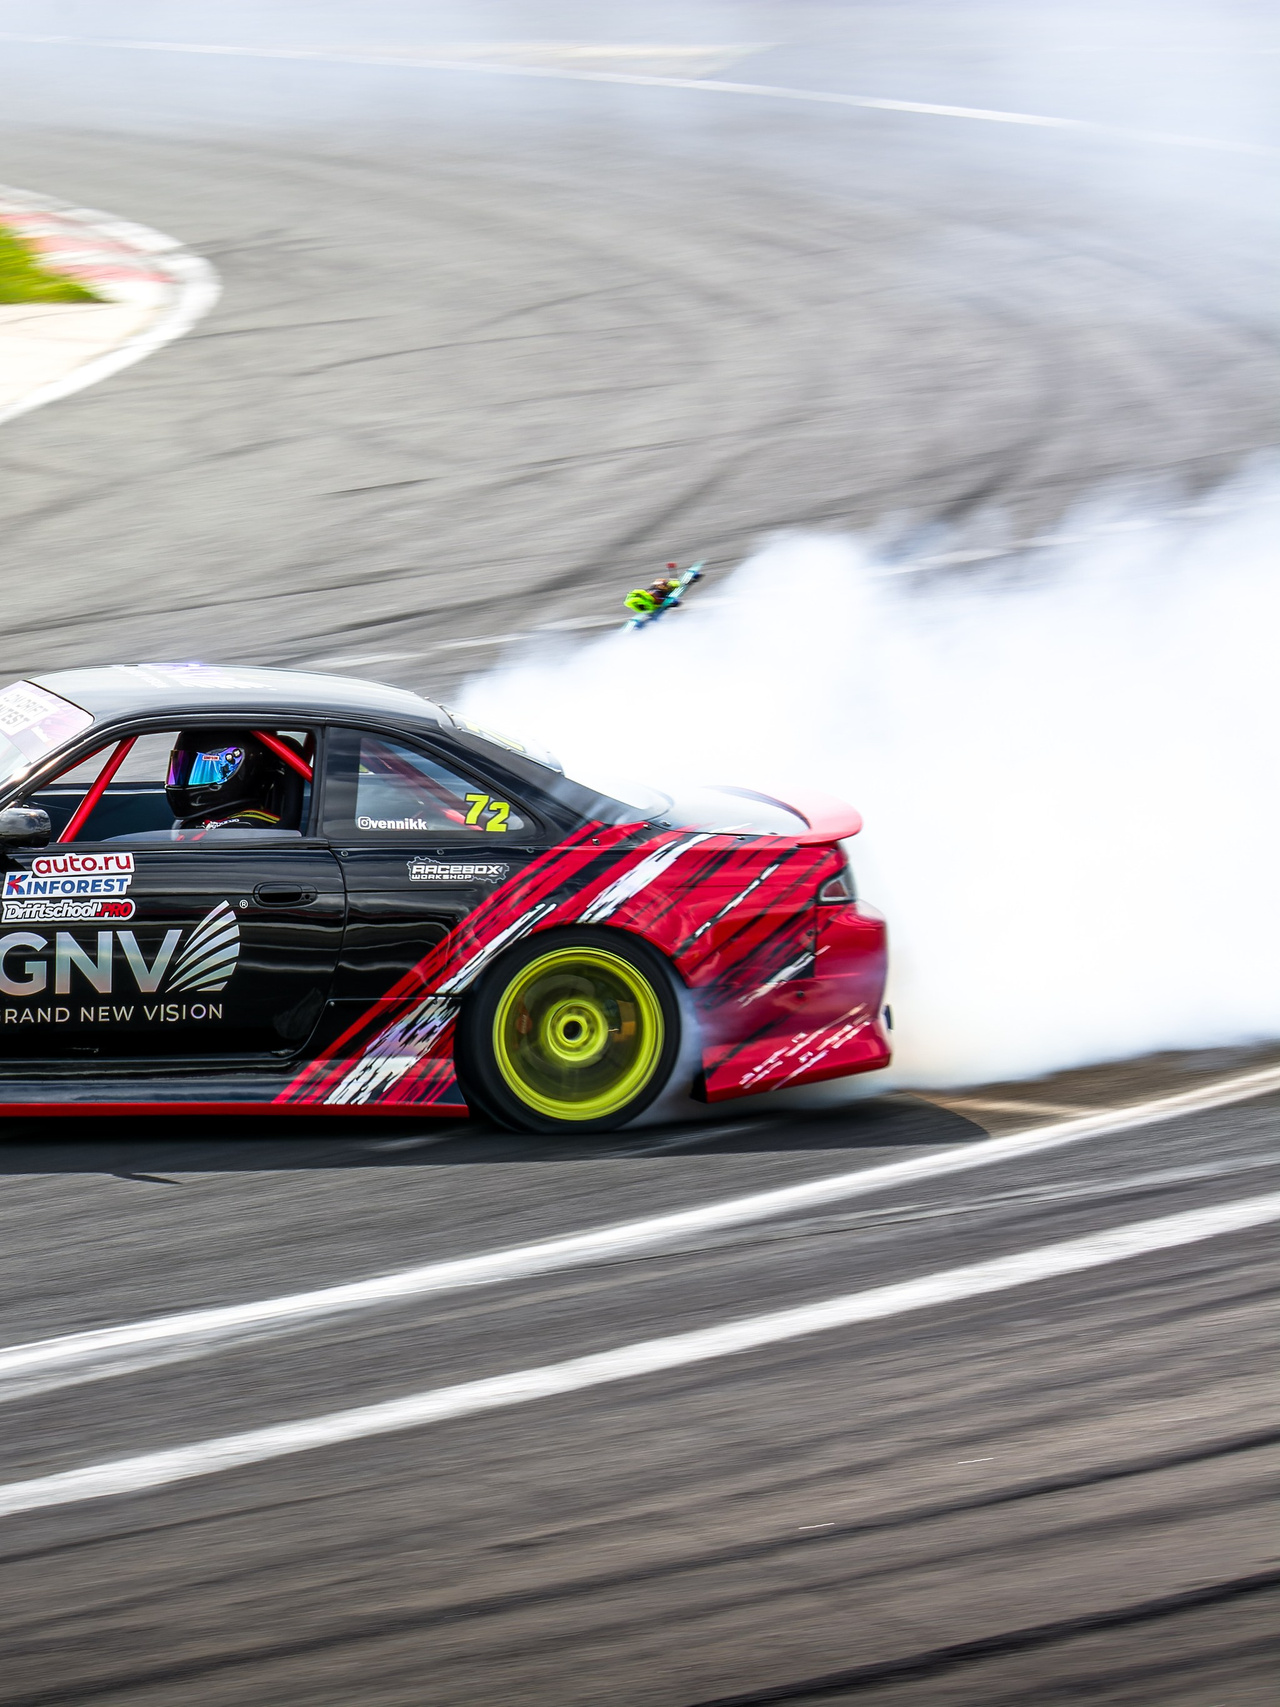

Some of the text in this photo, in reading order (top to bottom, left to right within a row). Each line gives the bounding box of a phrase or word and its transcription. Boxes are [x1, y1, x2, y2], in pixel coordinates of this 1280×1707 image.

[465, 794, 510, 832] 72
[370, 818, 428, 831] vennikk
[35, 854, 132, 874] auto.ru
[6, 875, 128, 896] KINFOREST
[80, 1005, 134, 1022] NEW
[144, 1003, 223, 1022] VISION
